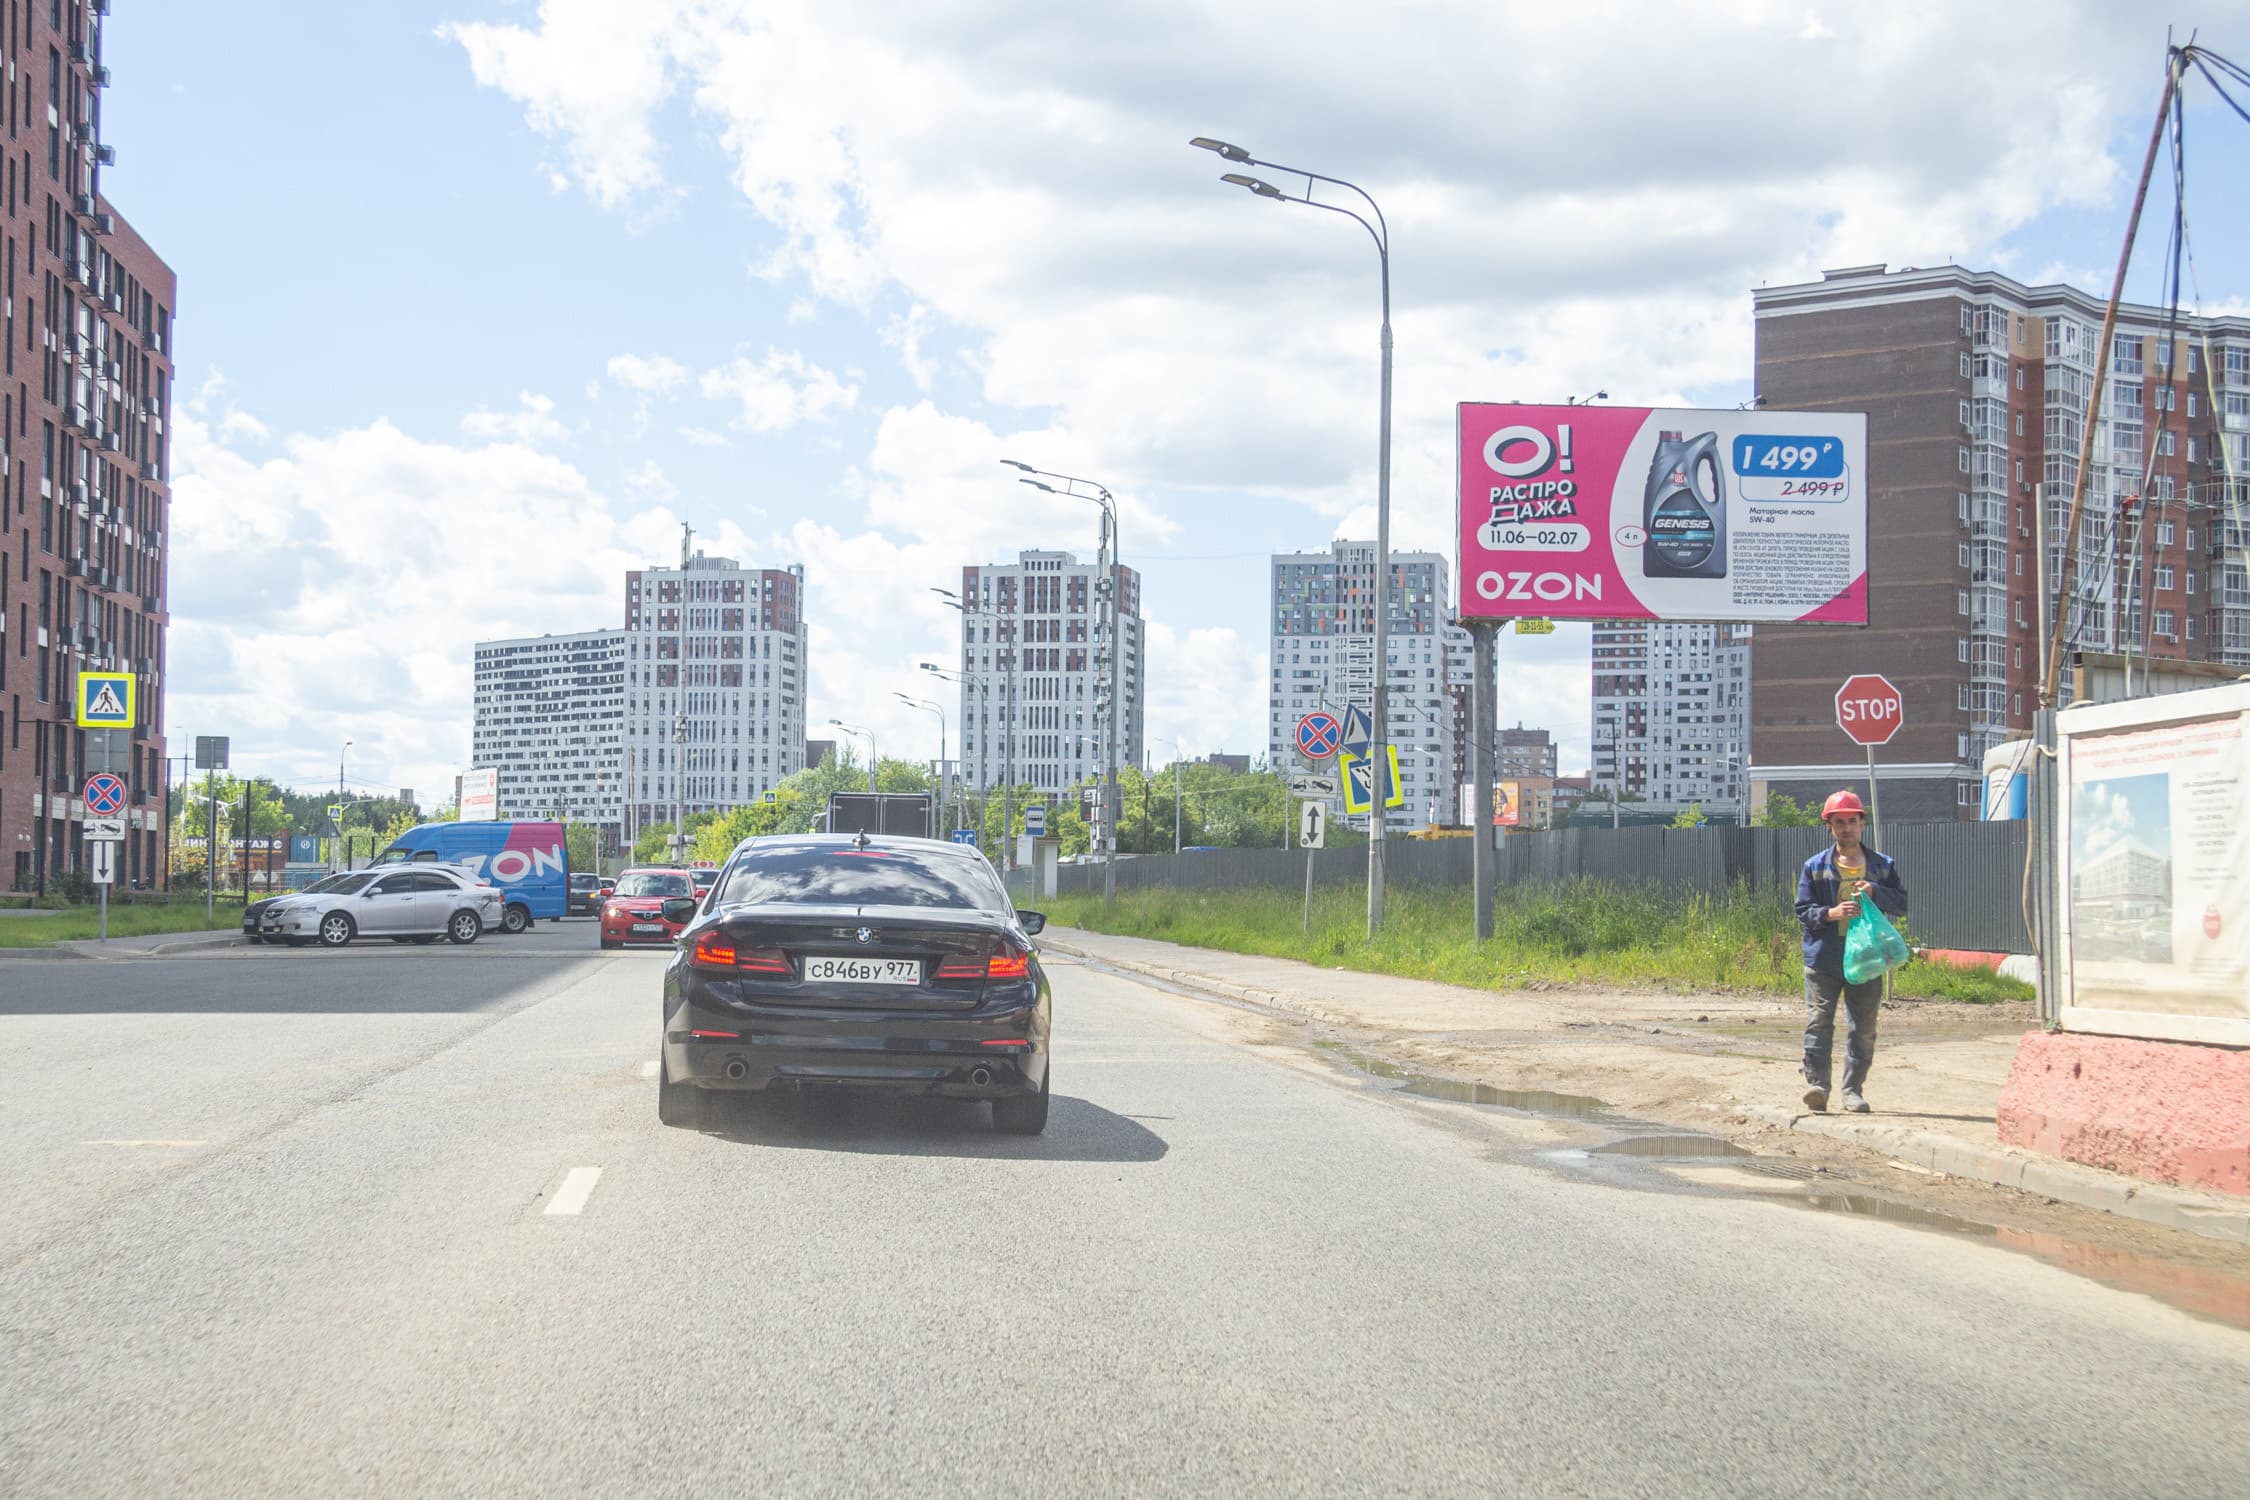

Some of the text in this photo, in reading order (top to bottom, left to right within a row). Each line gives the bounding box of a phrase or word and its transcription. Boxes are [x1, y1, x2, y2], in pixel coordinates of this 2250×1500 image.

[1760, 446, 1818, 471] 499
[1490, 479, 1574, 503] РАСПРО
[1798, 481, 1829, 496] 499
[1489, 498, 1574, 524] ДАЖА
[1749, 507, 1789, 516] Моторное
[1749, 516, 1775, 524] 5W-40
[1655, 518, 1710, 529] GENESIS
[1476, 570, 1602, 601] OZON
[1842, 698, 1897, 721] STOP
[461, 844, 563, 886] ZON
